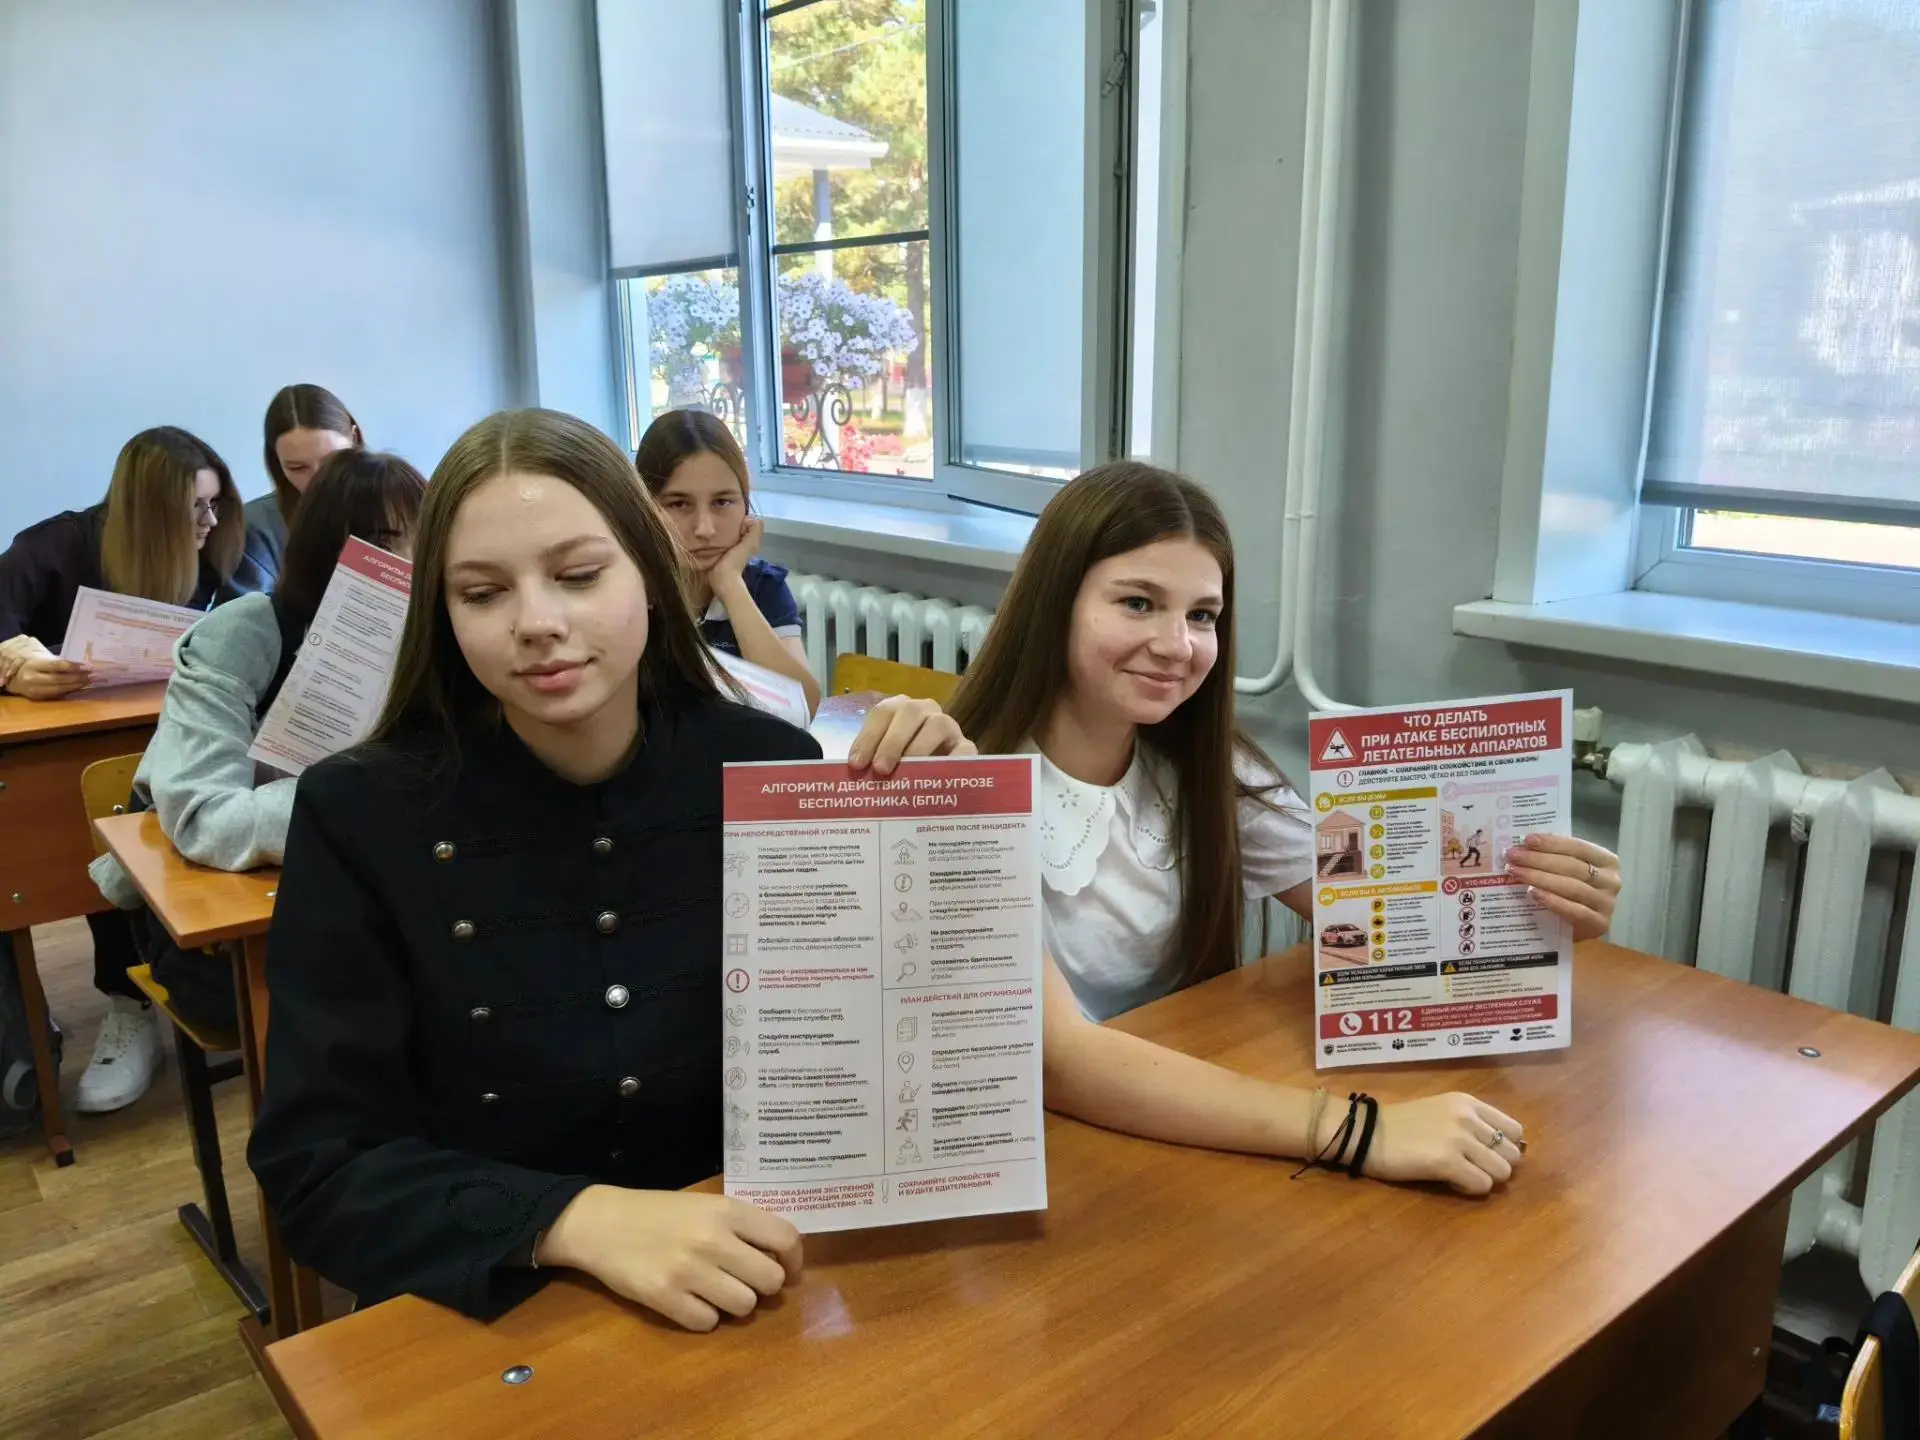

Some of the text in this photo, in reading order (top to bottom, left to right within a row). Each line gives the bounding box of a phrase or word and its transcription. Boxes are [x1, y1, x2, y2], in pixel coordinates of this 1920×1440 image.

[1404, 710, 1487, 727] ЧТО ДЕЛАТЬ
[1361, 720, 1546, 747] ПРИ АТАКЕ БЕСПИЛОТНЫХ
[1362, 735, 1548, 763] ЛЕТАТЕЛЬНЫХ АППАРАТОВ
[1359, 767, 1388, 776] ГЛАВНОЕ
[1396, 763, 1438, 773] СОХРАНЯЙТЕ
[1440, 760, 1487, 770] СПОКОЙСТВИЕ
[761, 777, 994, 793] АЛГОРИТМ ДЕЙСТВИЙ ПРИ УГРОЗЕ
[799, 794, 958, 809] БЕСПИЛОТНИКА (БПЛА)
[741, 829, 820, 838] НЕПОСРЕДСТВЕННОЙ
[916, 825, 954, 833] ДЕЙСТВИЯ
[940, 927, 993, 936] распространяйте
[971, 955, 1013, 963] бдительными
[900, 987, 1032, 1004] ПЛАН ДЕЙСТВИЙ ДЛЯ ОРГАНИЗАЦИЙ
[1368, 1009, 1413, 1032] 112
[1421, 1006, 1450, 1015] ЕДИНЫЙ
[1475, 1001, 1517, 1010] ЭКСТРЕННЫХ
[1519, 998, 1542, 1006] СЛУЖБ
[932, 1042, 1034, 1056] Определите безопасные укрытия
[932, 1075, 1017, 1089] Обучите правилам
[932, 1105, 965, 1114] Проводите
[759, 1130, 842, 1139] Сохраняйте спокойствие,
[985, 1139, 1013, 1147] действий
[898, 1171, 1000, 1188] СОХРАНЯЙТЕ СПОКОЙСТВИЕ
[734, 1182, 874, 1197] НОМЕР ДЛЯ ОКАЗАНИЯ ЭКСТРЕННОЙ
[905, 1186, 933, 1196] БУДЬТЕ
[935, 1180, 993, 1193] БДИТЕЛЬНЫМИ.
[753, 1197, 789, 1205] ПОМОЩИ
[797, 1194, 840, 1204] СИТУАЦИИ
[841, 1191, 874, 1199] ЛЮБОГО
[793, 1200, 856, 1212] ПРОИСШЕСТВИЯ
